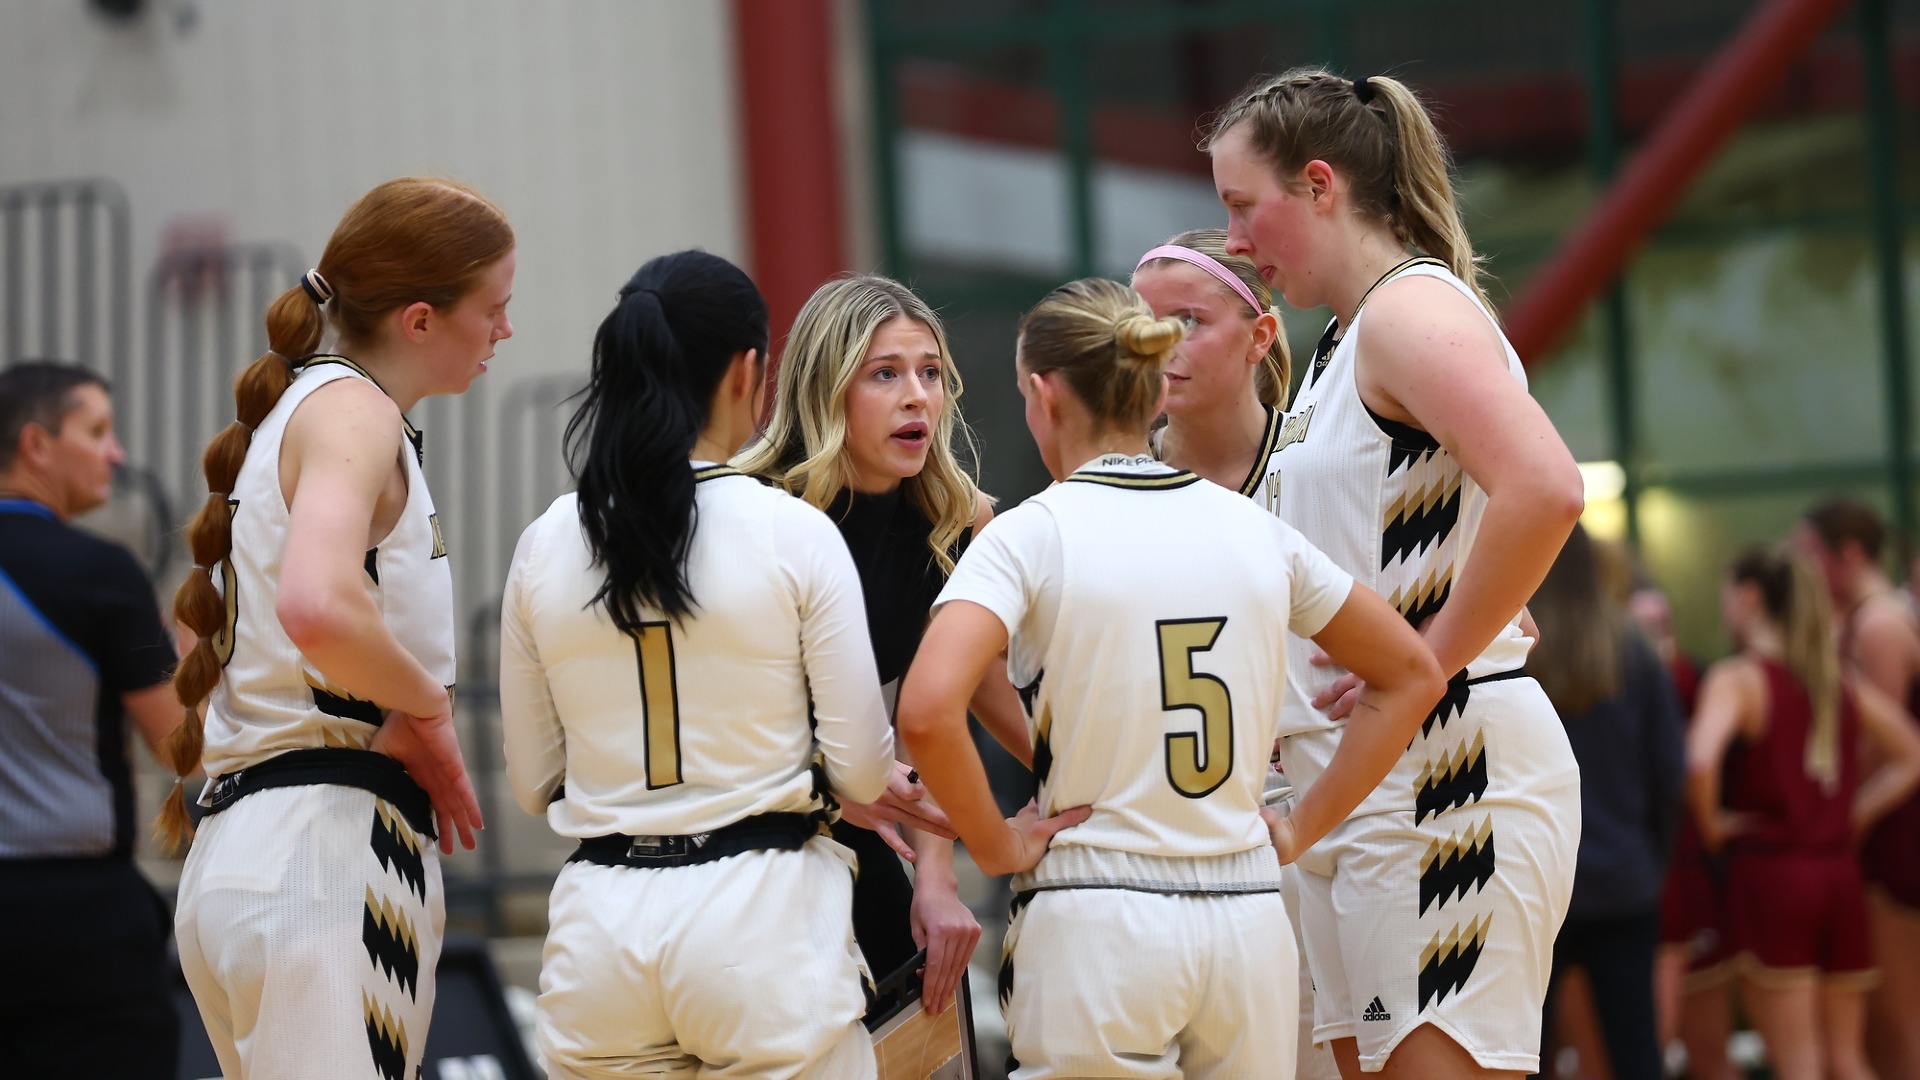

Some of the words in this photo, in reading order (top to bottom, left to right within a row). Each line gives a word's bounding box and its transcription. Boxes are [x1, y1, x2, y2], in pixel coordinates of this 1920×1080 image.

[1102, 457, 1134, 467] NIKE
[618, 620, 685, 791] 1
[1155, 616, 1234, 799] 5
[1362, 1011, 1391, 1022] adidas
